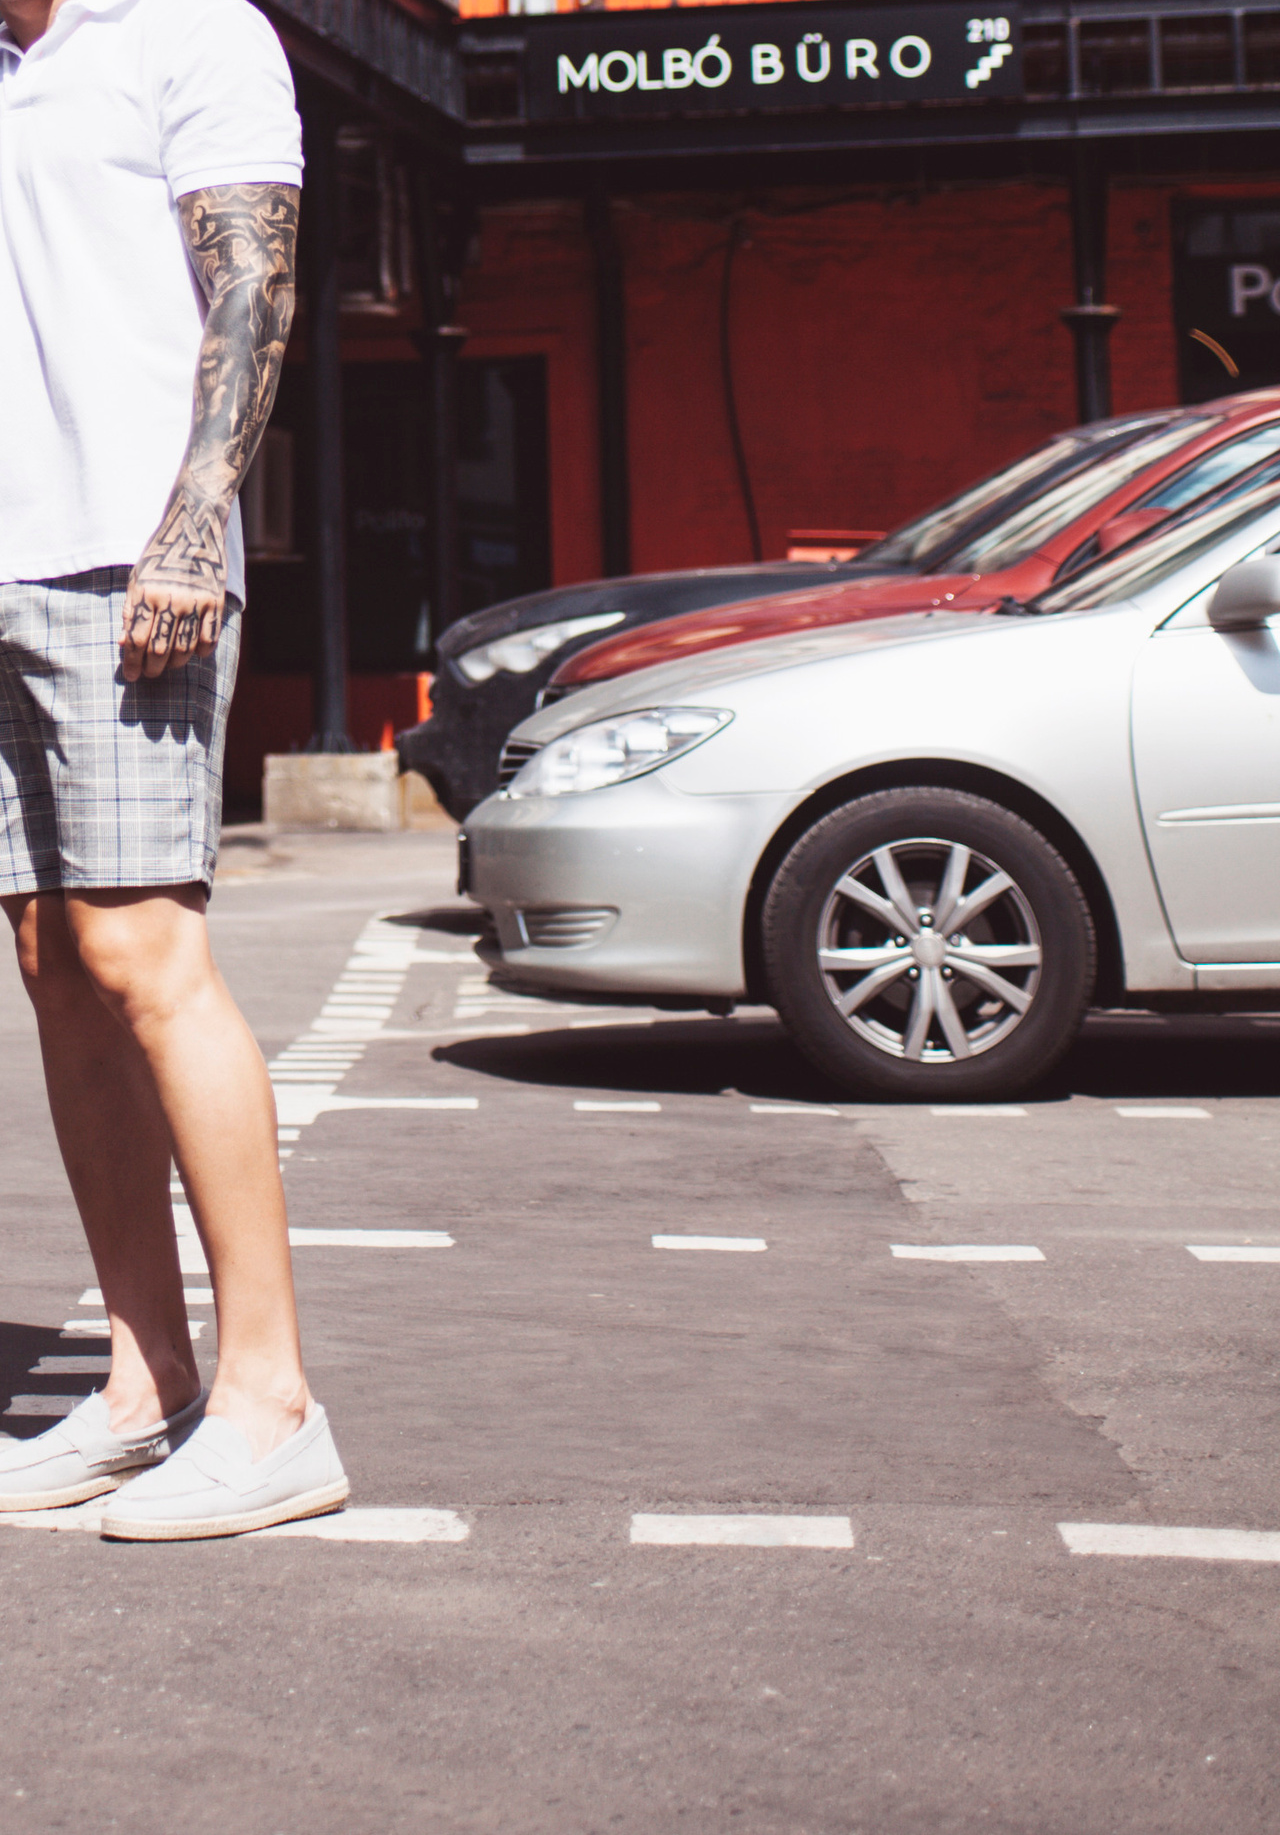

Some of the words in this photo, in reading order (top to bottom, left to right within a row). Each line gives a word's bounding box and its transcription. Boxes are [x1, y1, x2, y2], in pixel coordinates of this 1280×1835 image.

[558, 33, 732, 95] MOLBÓ
[751, 32, 932, 85] BÜRO
[1231, 264, 1280, 317] P
